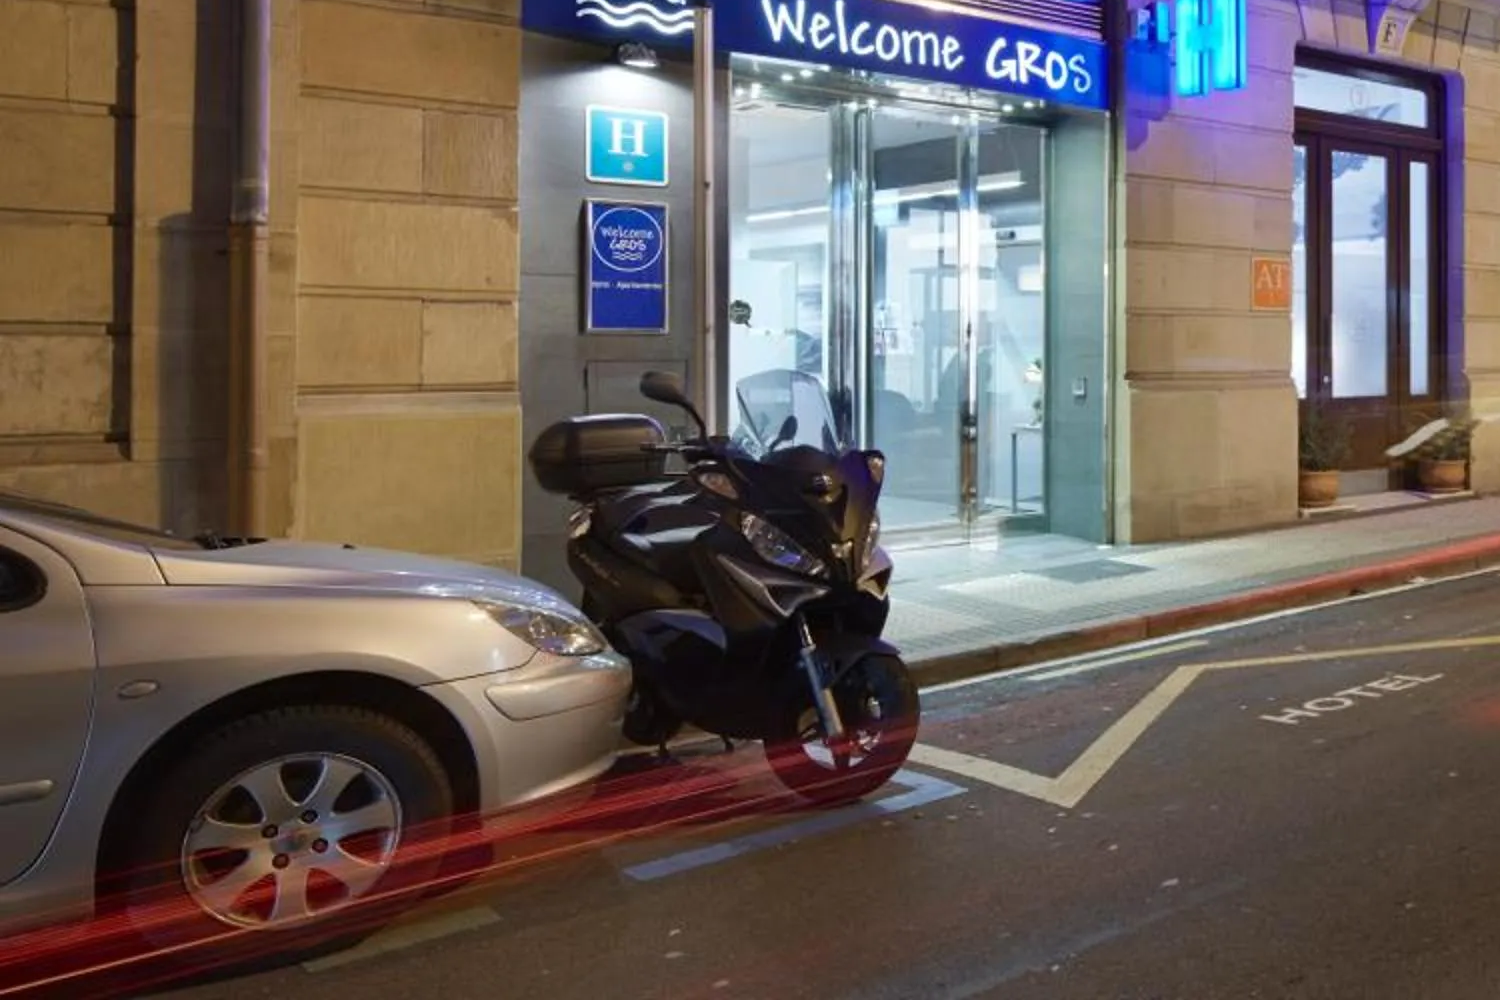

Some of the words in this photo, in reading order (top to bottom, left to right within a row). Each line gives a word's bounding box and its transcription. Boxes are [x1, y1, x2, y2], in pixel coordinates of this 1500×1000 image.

[986, 37, 1092, 93] GROS
[607, 117, 649, 157] H
[599, 224, 655, 240] Welcome
[609, 237, 646, 251] GROS
[1257, 264, 1286, 289] AT
[1258, 673, 1445, 724] HOTEL
